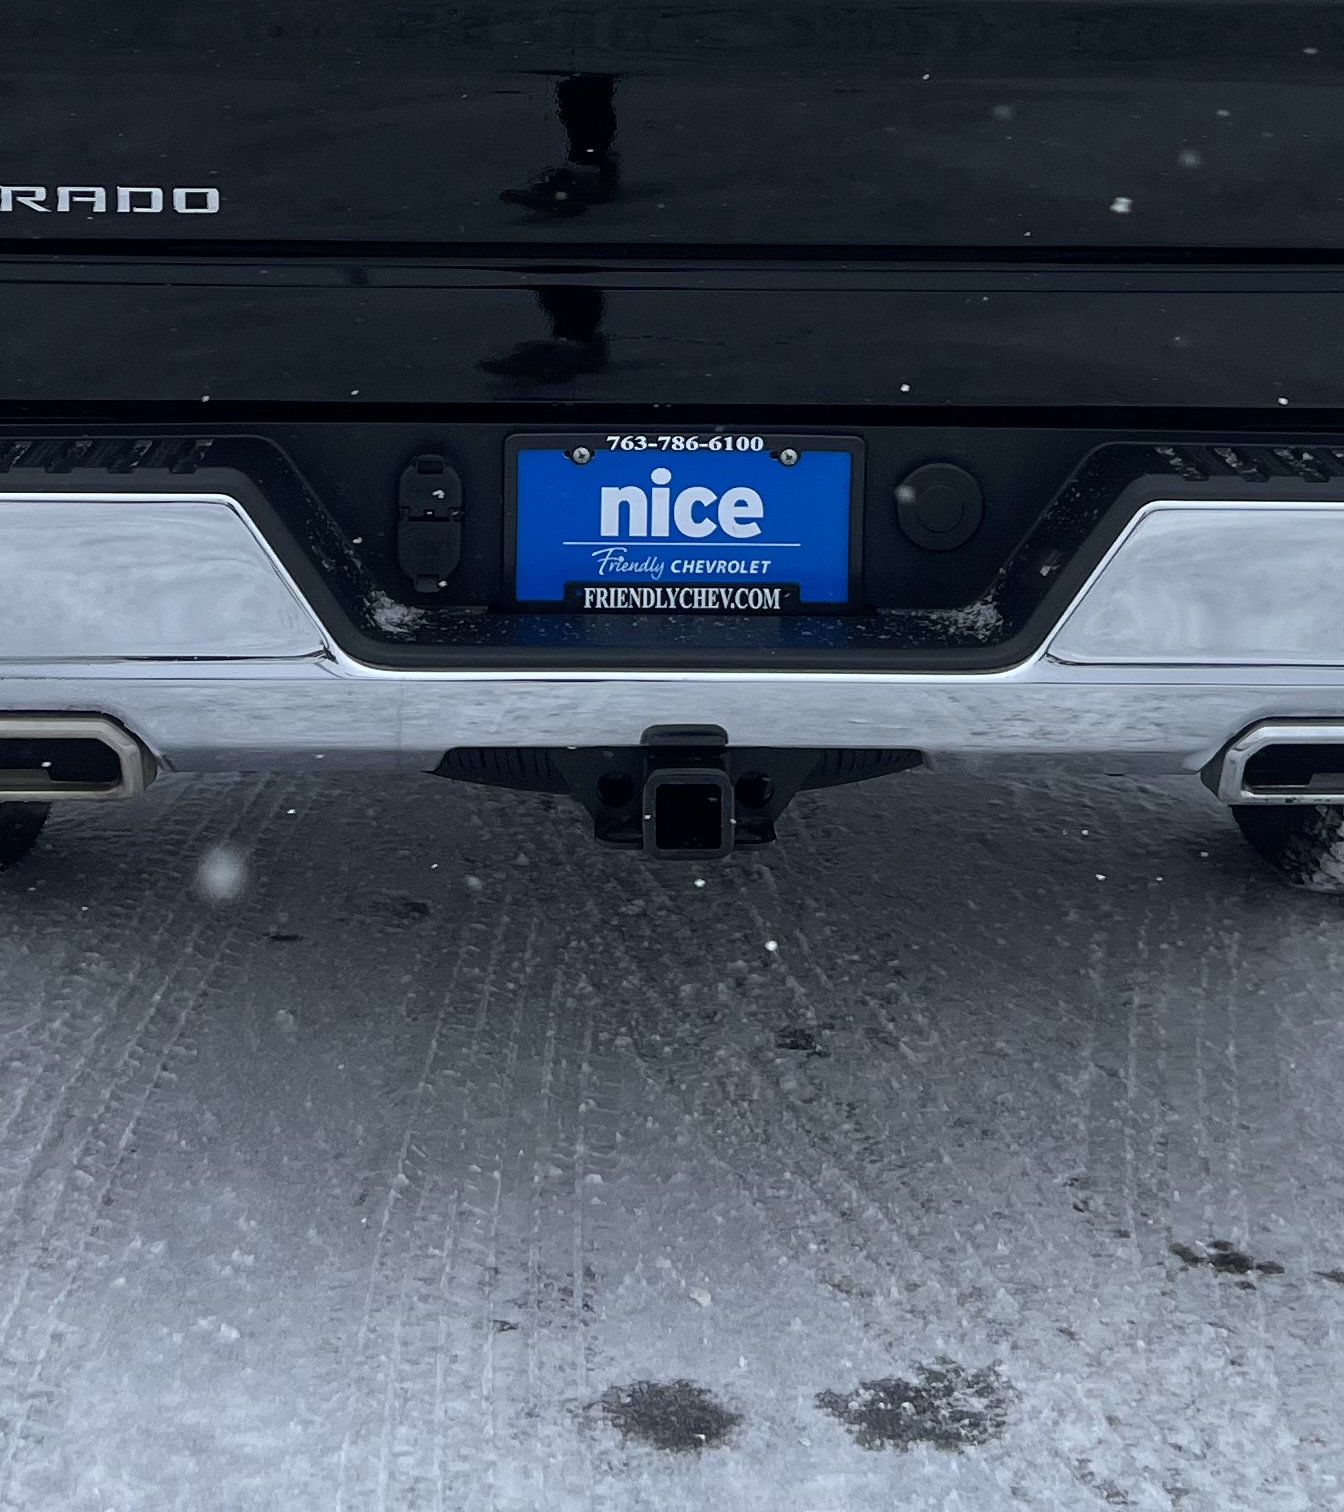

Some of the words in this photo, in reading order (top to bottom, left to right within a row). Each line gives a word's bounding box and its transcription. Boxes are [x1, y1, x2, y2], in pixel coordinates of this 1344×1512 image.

[606, 435, 764, 452] 763-786-6100
[600, 467, 764, 539] nice
[591, 547, 665, 581] Friendly
[670, 558, 772, 575] CHEVROLET
[583, 587, 781, 610] FRIENDLYCHEV.COM
